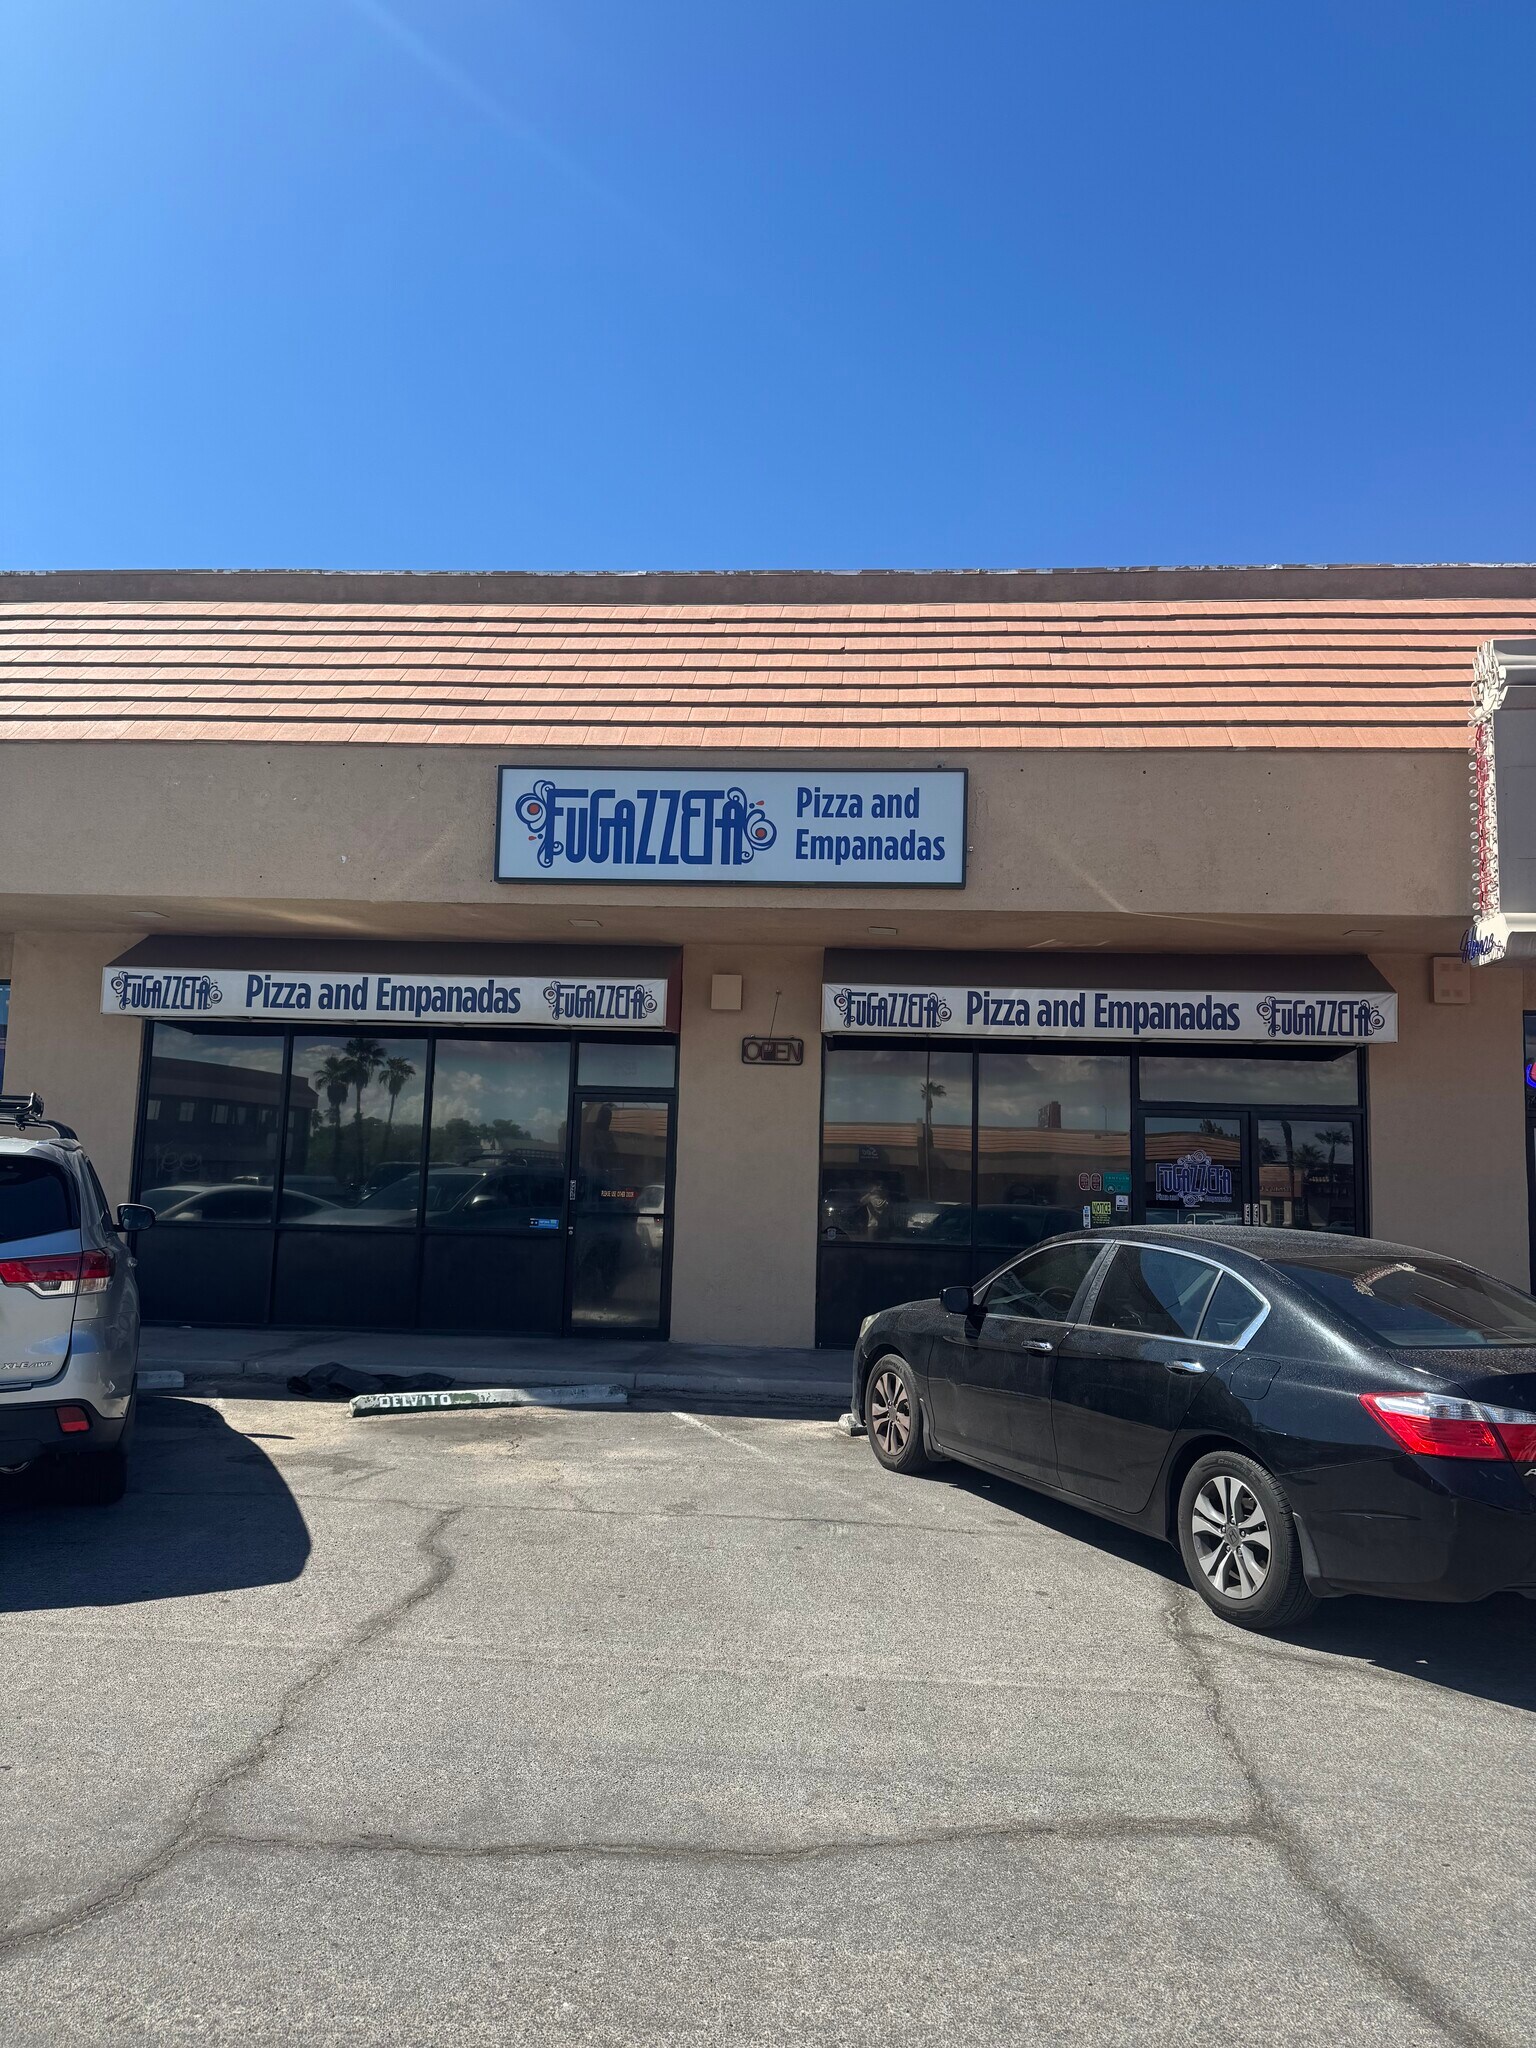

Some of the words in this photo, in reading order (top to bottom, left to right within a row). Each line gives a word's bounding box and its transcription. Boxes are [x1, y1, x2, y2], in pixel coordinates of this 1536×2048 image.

[795, 786, 863, 819] Pizza
[870, 786, 920, 820] and
[546, 788, 743, 866] FUGAZZETA
[795, 828, 946, 866] Empanadas
[122, 974, 211, 1010] FUGAZZETA
[246, 974, 312, 1010] Pizza
[318, 976, 369, 1011] and
[376, 977, 521, 1018] Empanadas
[555, 984, 645, 1020] FUGAZZETA
[847, 991, 939, 1028] FUGAZZETA
[966, 990, 1030, 1026] Pizza
[1036, 992, 1086, 1028] and
[1094, 992, 1240, 1036] Empanadas
[1271, 999, 1371, 1037] FUGAZZETA
[745, 1041, 802, 1062] OPEN
[1092, 1202, 1111, 1214] NOTICE
[1, 1361, 29, 1370] XLE
[378, 1394, 452, 1408] DELVITO
